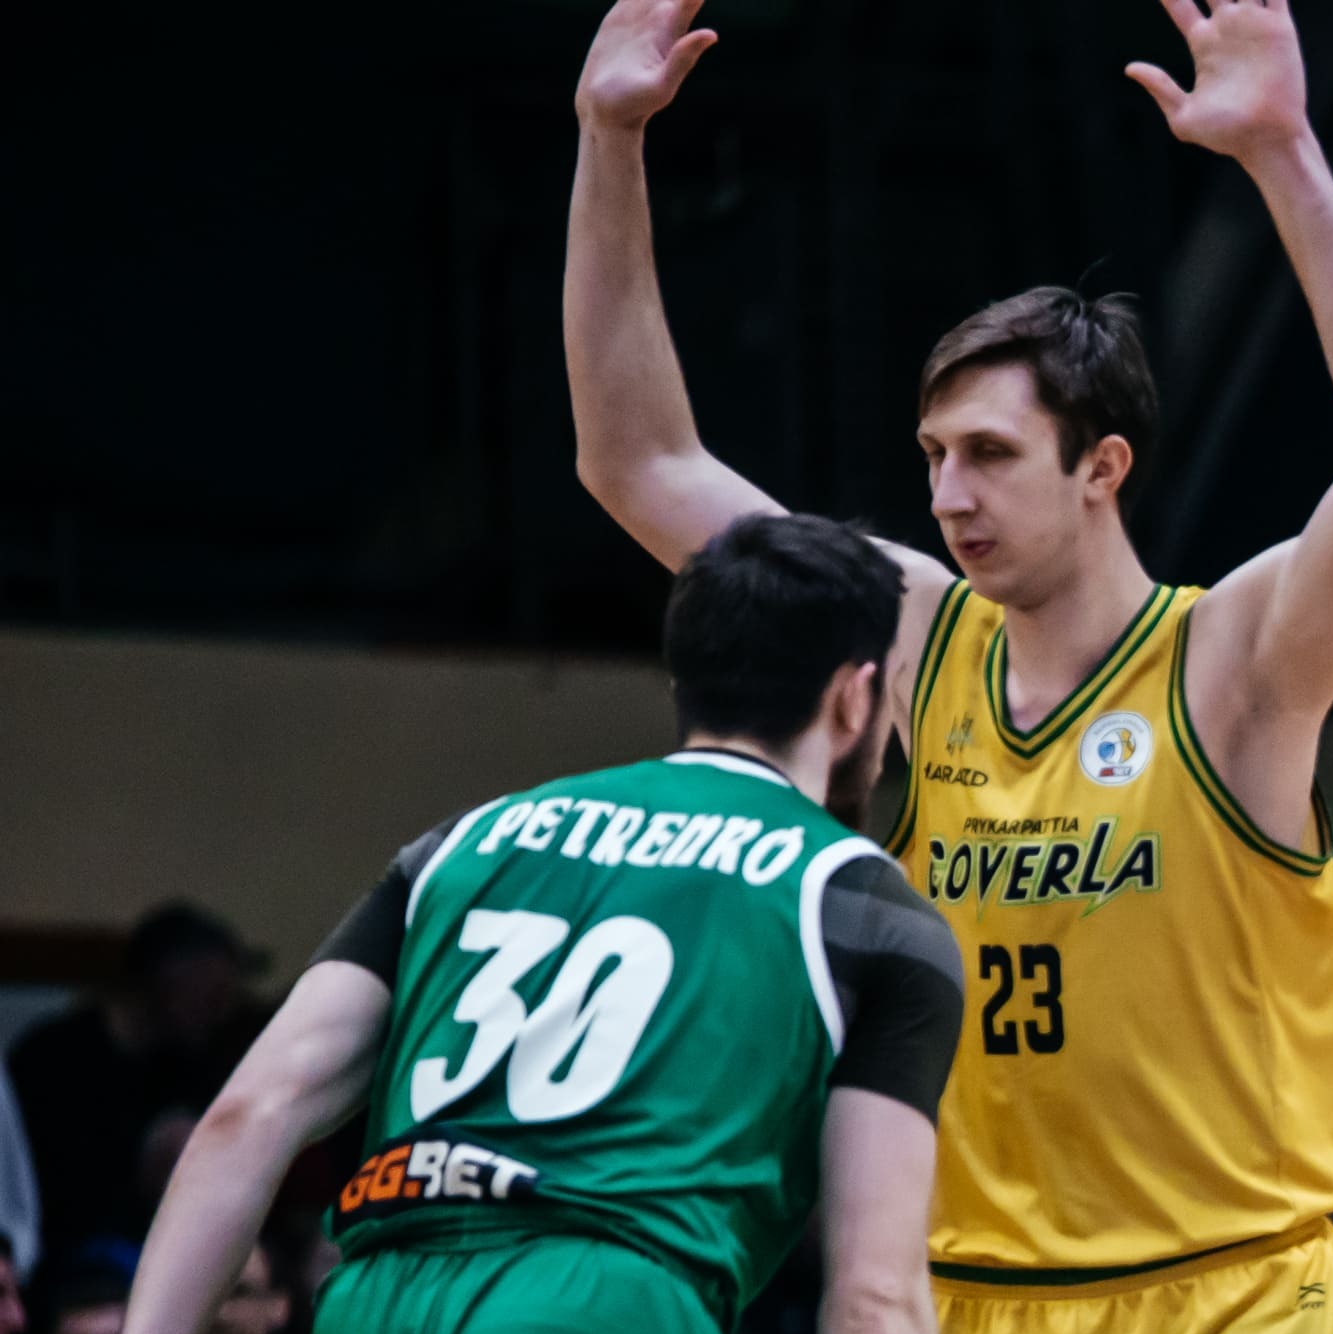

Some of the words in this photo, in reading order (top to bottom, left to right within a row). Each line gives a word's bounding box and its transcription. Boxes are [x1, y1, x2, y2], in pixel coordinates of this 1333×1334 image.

[409, 908, 674, 1124] 30
[978, 943, 1065, 1056] 23
[339, 1140, 539, 1214] GG.BET
